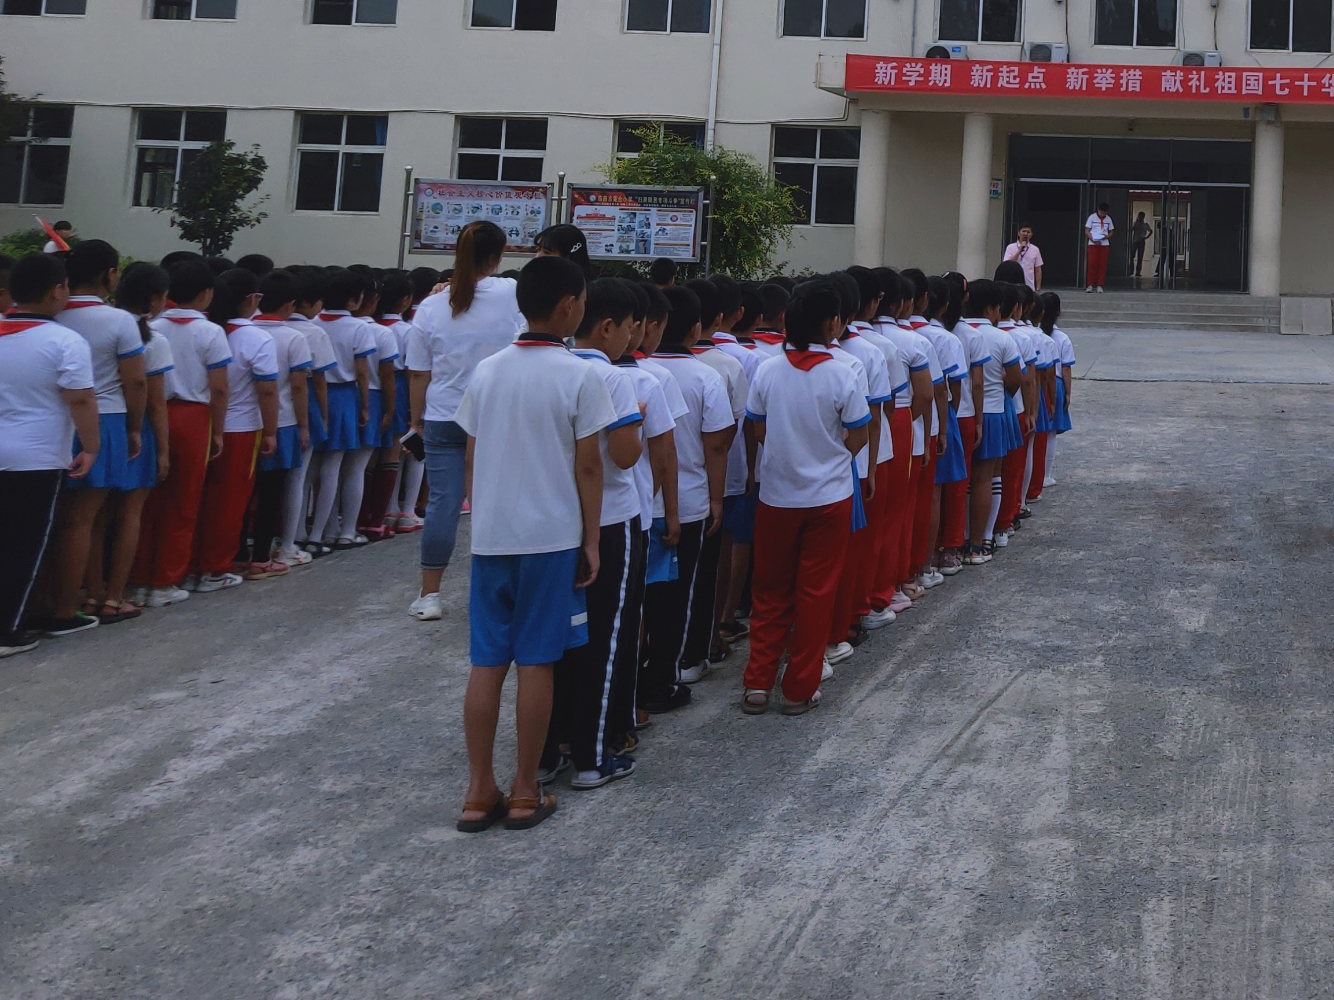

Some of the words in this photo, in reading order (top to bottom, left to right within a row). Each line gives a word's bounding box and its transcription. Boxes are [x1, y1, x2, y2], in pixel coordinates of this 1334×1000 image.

[874, 61, 952, 87] 新学期
[970, 63, 1047, 89] 新起点
[1065, 67, 1143, 92] 新举措
